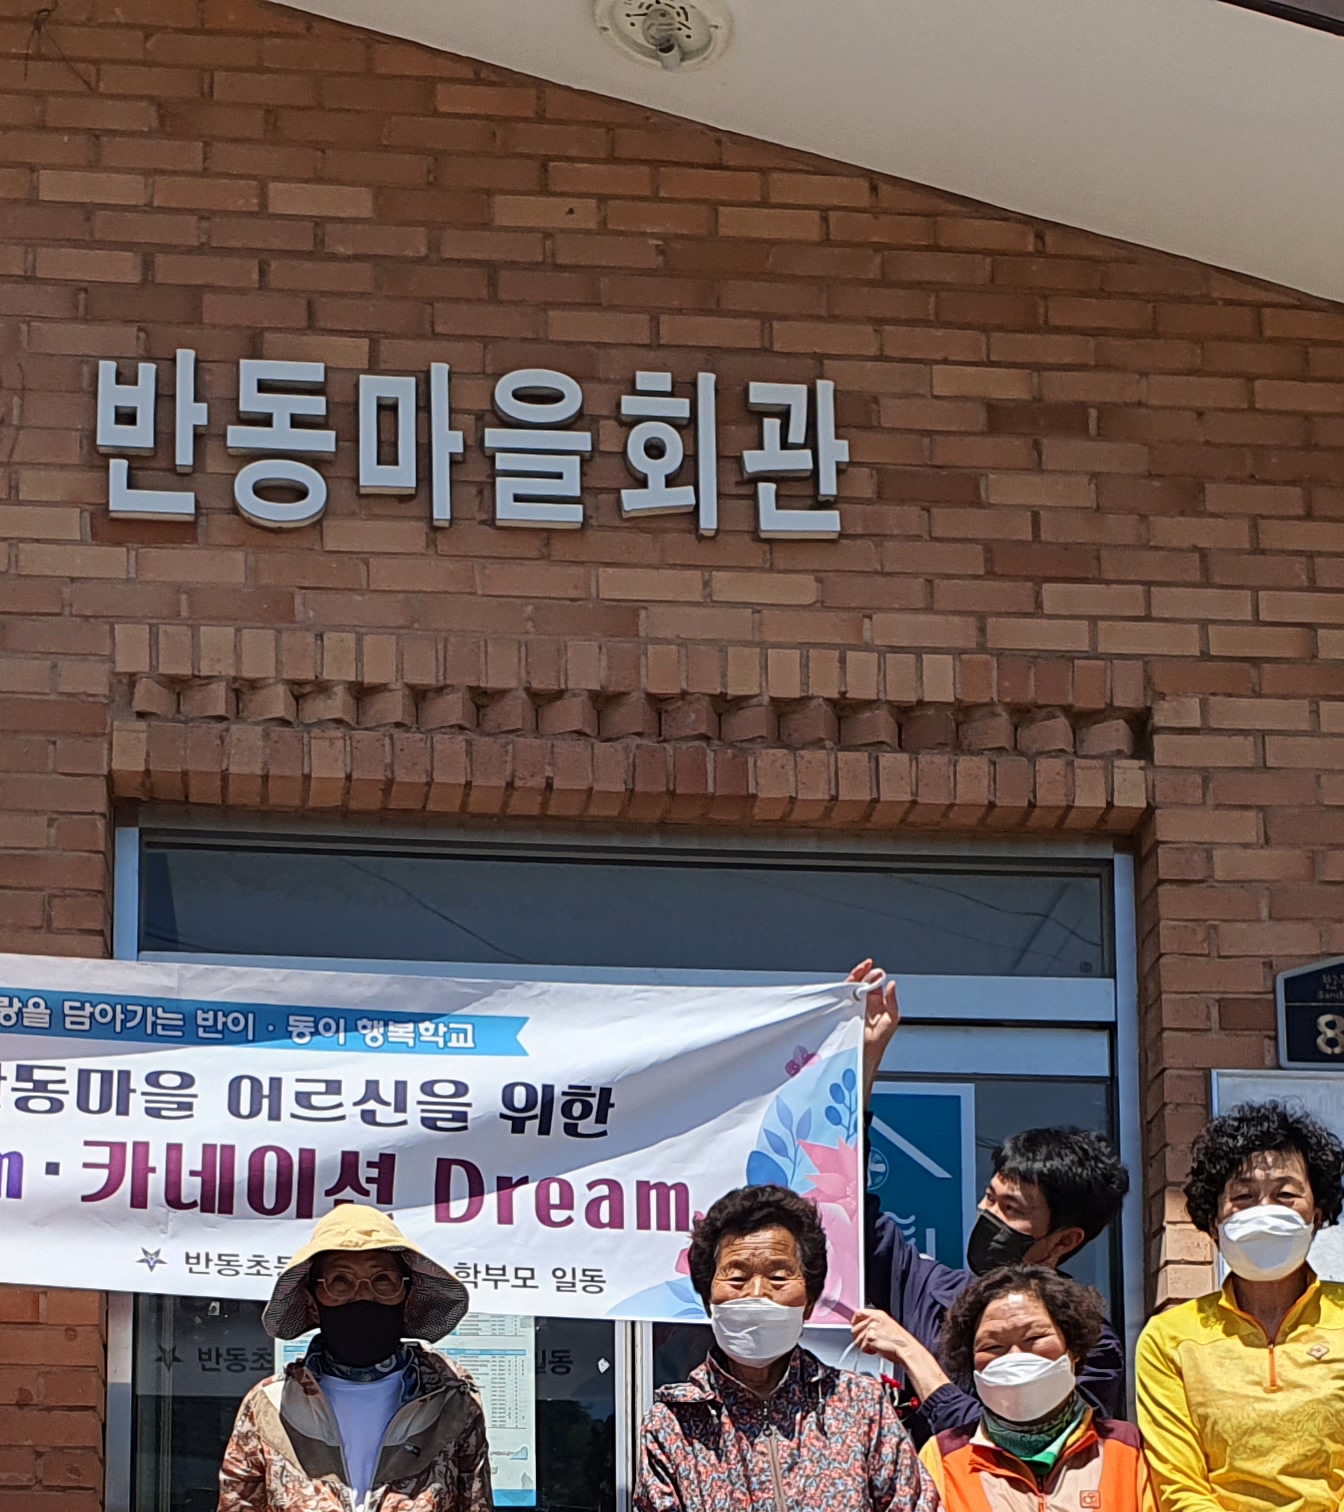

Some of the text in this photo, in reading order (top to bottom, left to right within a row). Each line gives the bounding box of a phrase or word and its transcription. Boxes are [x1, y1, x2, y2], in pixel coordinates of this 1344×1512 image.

[94, 347, 850, 541] 반동마을회관
[62, 1000, 184, 1037] 담아가는
[196, 1009, 254, 1041] 반이
[287, 1015, 346, 1045] 동이
[357, 1017, 476, 1049] 행복학교
[227, 1074, 473, 1132] 어르신을
[500, 1080, 615, 1139] 위한
[434, 1157, 692, 1232] Dream
[453, 1261, 540, 1291] 학부모
[551, 1266, 607, 1295] 일동
